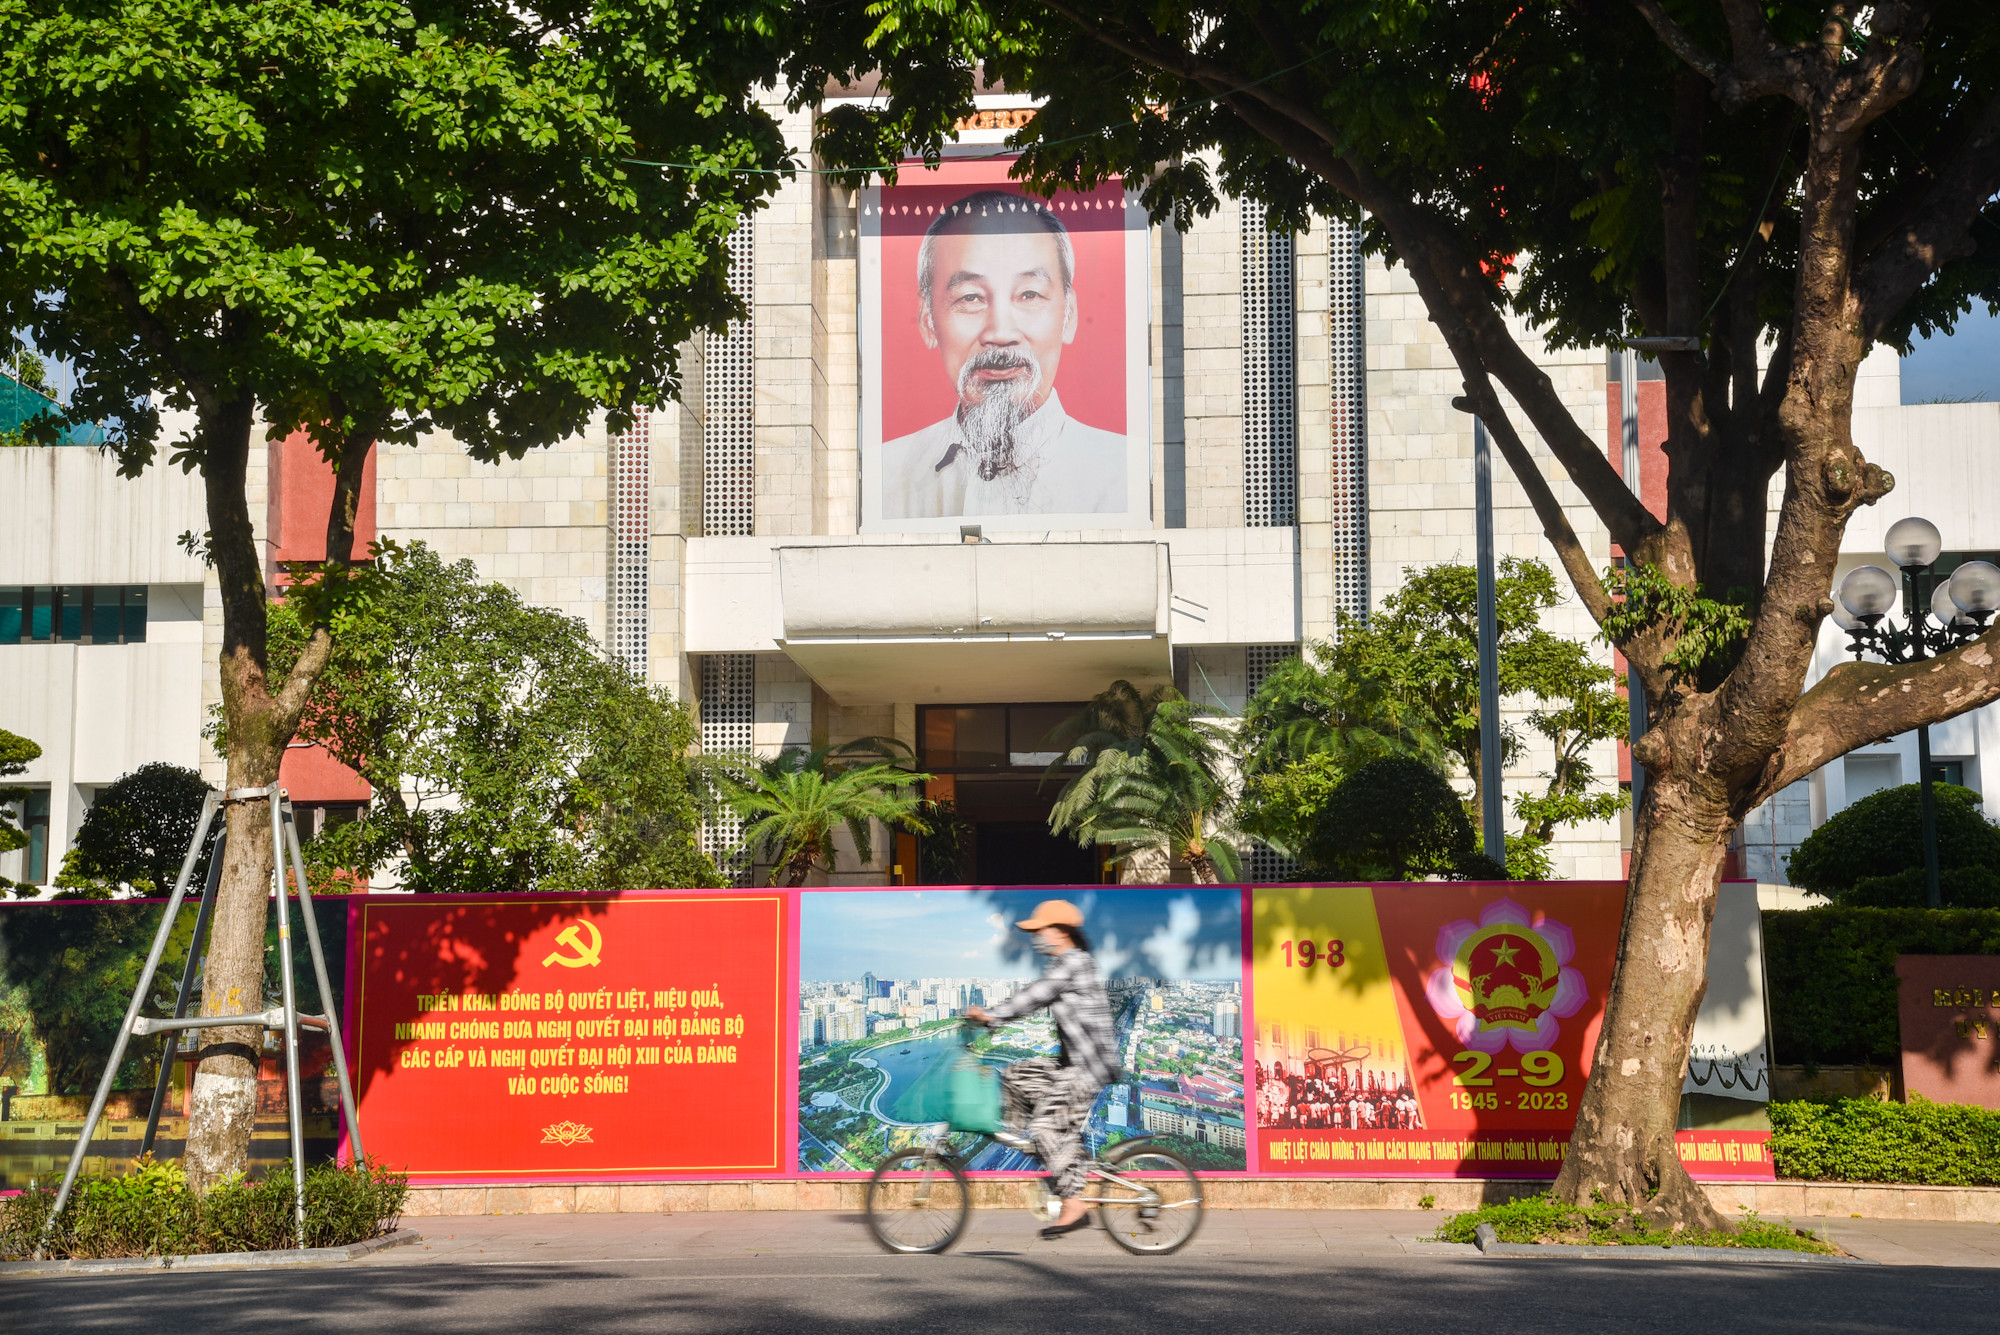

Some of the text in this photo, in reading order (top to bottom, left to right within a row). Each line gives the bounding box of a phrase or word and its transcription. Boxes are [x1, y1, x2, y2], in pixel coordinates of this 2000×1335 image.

[1281, 940, 1345, 968] 19-8
[417, 983, 724, 1014] TRIỂN KHAI ĐỒNG BỘ QUYẾT LIỆT, HIỆU QUẢ,
[395, 1011, 744, 1042] NHANH CHÓNG ĐƯA NGHỊ QUYẾT ĐẠI HỘI ĐẢNG BỘ
[401, 1038, 736, 1070] CÁC CẤP VÀ NGHỊ QUYẾT ĐẠI HỘI XIII CỦA ĐẢNG
[1452, 1050, 1564, 1086] 2-9
[508, 1070, 628, 1098] VÀO CUỘC SỐNG!
[1450, 1092, 1498, 1110] 1945
[1518, 1092, 1568, 1110] 2023
[1270, 1138, 1291, 1164] NHIỆT
[1293, 1138, 1308, 1164] LIỆT
[1310, 1138, 1330, 1160] CHÀO
[1332, 1137, 1354, 1160] MỪNG
[1356, 1142, 1366, 1160] 78
[1366, 1138, 1384, 1160] NĂM
[1386, 1138, 1406, 1160] CÁCH
[1408, 1142, 1431, 1164] MẠNG
[1432, 1138, 1458, 1160] THÁNG
[1458, 1138, 1476, 1160] TÁM
[1477, 1138, 1502, 1160] THÀNH
[1504, 1138, 1526, 1160] CÔNG
[1526, 1138, 1537, 1160] VÀ
[1538, 1136, 1559, 1162] QUỐC
[1680, 1134, 1696, 1161] CHỦ
[1698, 1139, 1723, 1162] NGHĨA
[1723, 1138, 1740, 1166] VIỆT
[1742, 1143, 1762, 1162] NAM
